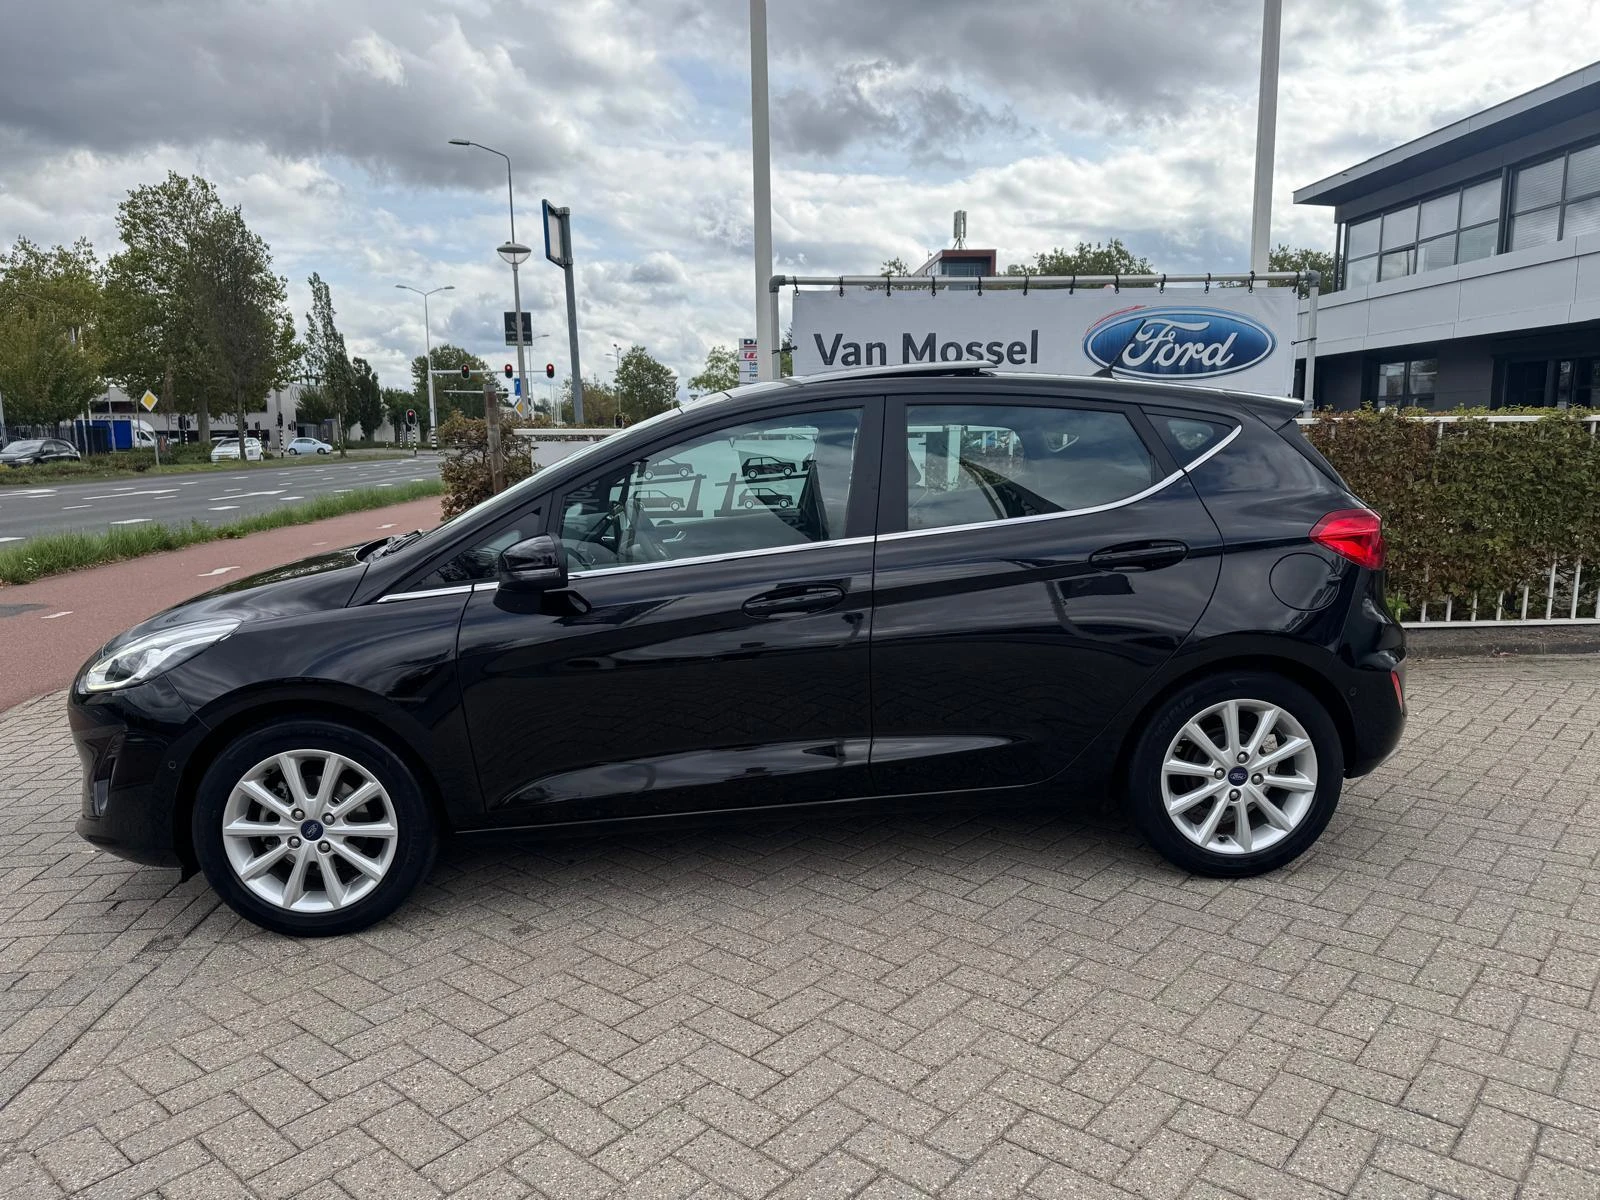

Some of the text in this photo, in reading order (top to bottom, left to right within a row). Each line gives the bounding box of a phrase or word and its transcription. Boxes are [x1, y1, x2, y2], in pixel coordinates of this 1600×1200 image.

[813, 329, 1038, 366] Van Mossel
[1122, 318, 1238, 367] Ford
